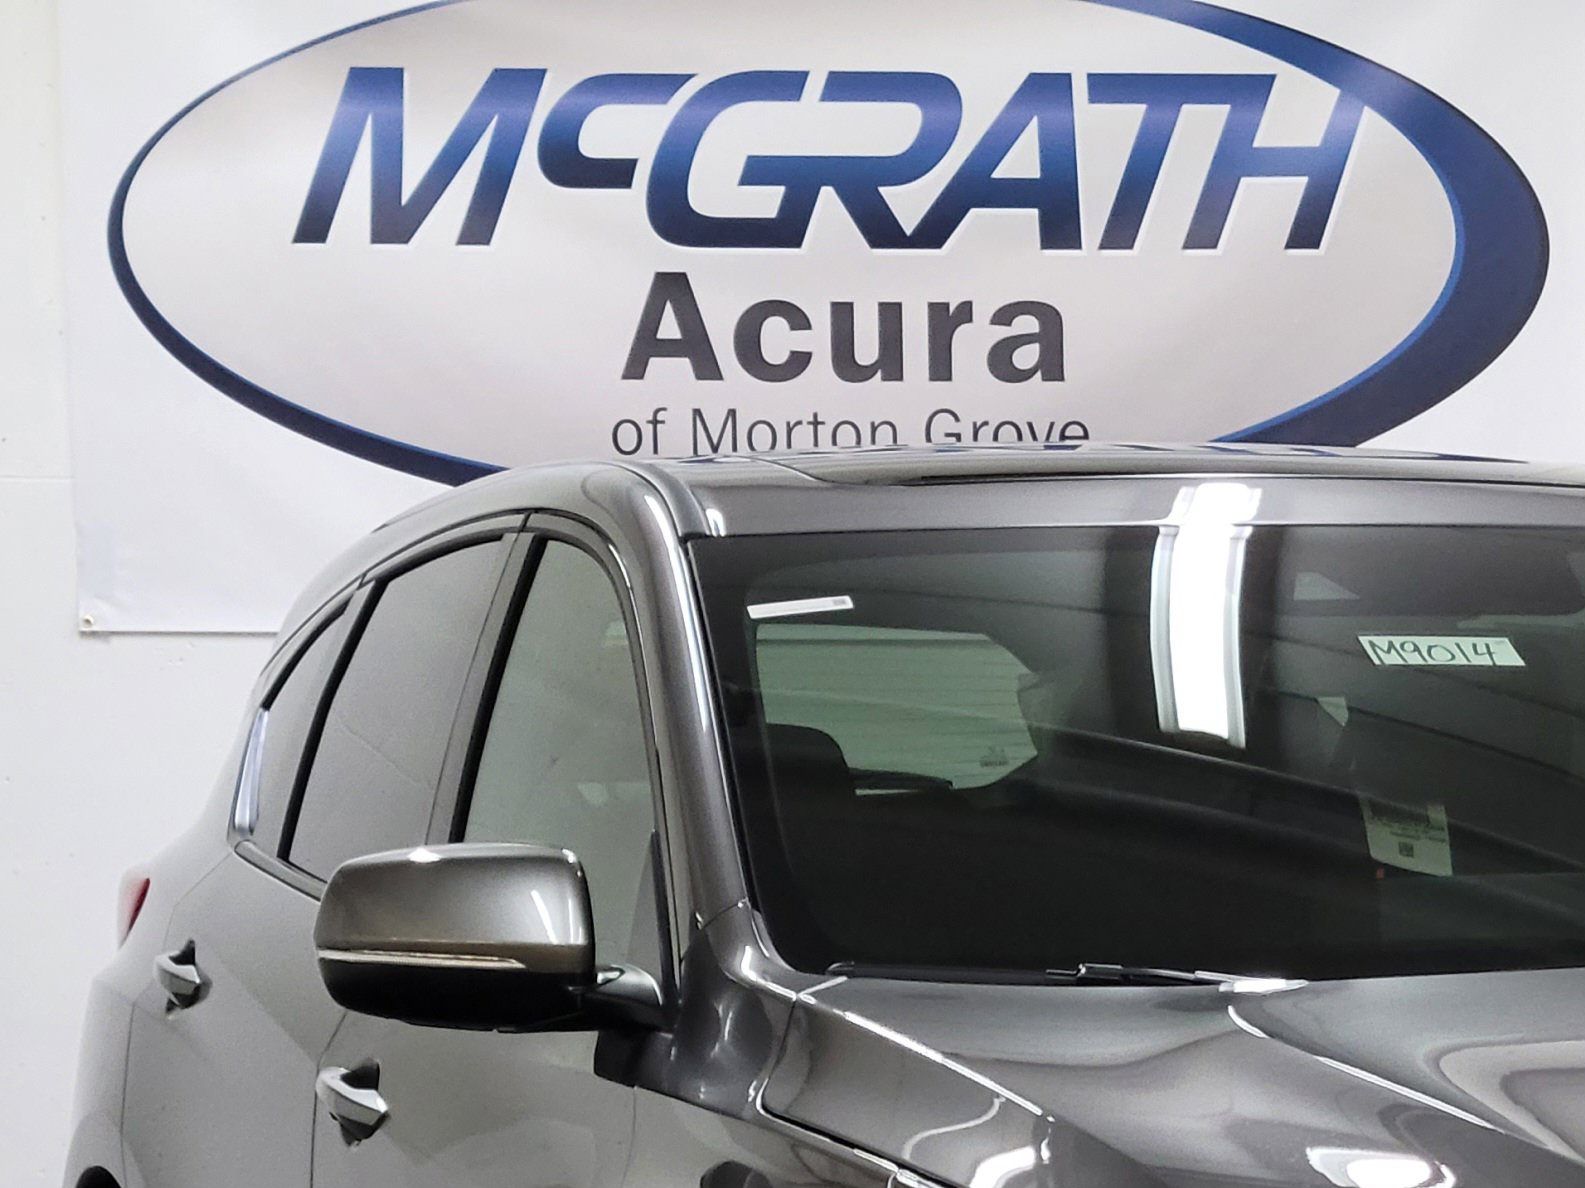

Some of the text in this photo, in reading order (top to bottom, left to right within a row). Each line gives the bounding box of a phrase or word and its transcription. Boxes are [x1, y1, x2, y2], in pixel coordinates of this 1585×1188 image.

[621, 271, 1066, 383] Acura
[611, 407, 1090, 456] of Morton Grove
[1368, 639, 1497, 666] M9014
